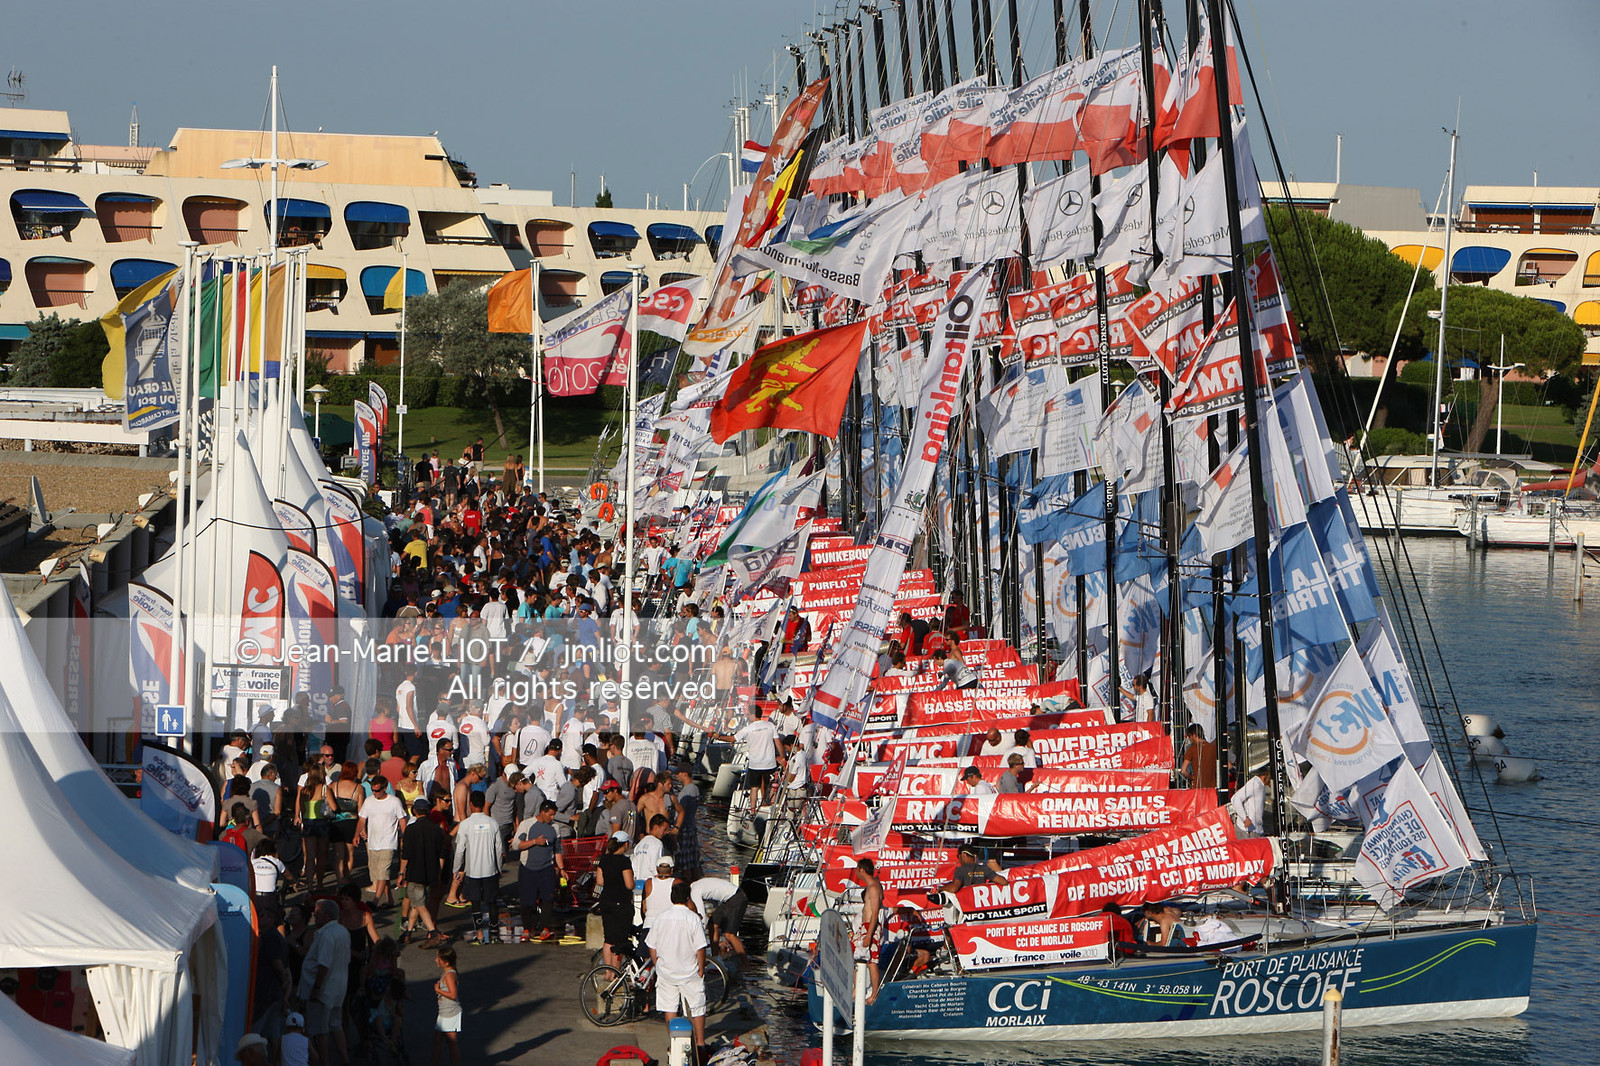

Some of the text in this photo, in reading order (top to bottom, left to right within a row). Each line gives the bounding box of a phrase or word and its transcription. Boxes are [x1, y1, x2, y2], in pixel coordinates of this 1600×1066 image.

[1101, 354, 1109, 385] LLOYD
[815, 547, 873, 565] DUNKERQU
[809, 580, 848, 591] PURFLO
[223, 667, 280, 678] tour france
[247, 679, 280, 691] voile
[962, 687, 1027, 699] MANCHE
[924, 700, 972, 715] BASSE
[869, 714, 898, 722] SPORT
[1494, 759, 1507, 774] 24
[1275, 739, 1286, 826] GENERALI
[906, 800, 963, 821] RMC
[1041, 795, 1166, 812] OMAN SAIL'S
[945, 824, 978, 832] SPORT
[1037, 811, 1171, 828] RENAISSANCE
[878, 850, 911, 861] OMAN
[1098, 861, 1133, 879] PORT
[1135, 857, 1153, 872] DE
[1155, 846, 1230, 870] PLAISANCE
[890, 867, 936, 880] NANTES
[1067, 884, 1088, 902] DE
[1089, 875, 1149, 898] ROSCOFF
[1159, 871, 1182, 887] CCI
[1184, 866, 1204, 883] DE
[1207, 859, 1265, 880] MORLAIX
[972, 881, 1030, 908] RMC
[963, 903, 1046, 921] NFO TALK SPORT
[986, 920, 1103, 938] PORT DE PLAISANCE DE ROSCOFF
[1016, 934, 1074, 948] CCI DE MORLAIX
[981, 956, 1003, 965] tour
[1014, 953, 1046, 963] france
[1060, 949, 1082, 959] voile
[1222, 948, 1365, 979] PORT DE PLAISANCE
[1097, 978, 1110, 988] 43
[1112, 980, 1137, 992] 141N
[1143, 983, 1157, 994] 3°
[1159, 984, 1190, 994] 58.058
[1191, 984, 1202, 995] W
[1209, 967, 1363, 1016] ROSCOFF
[985, 1014, 1047, 1027] MORLAIX
